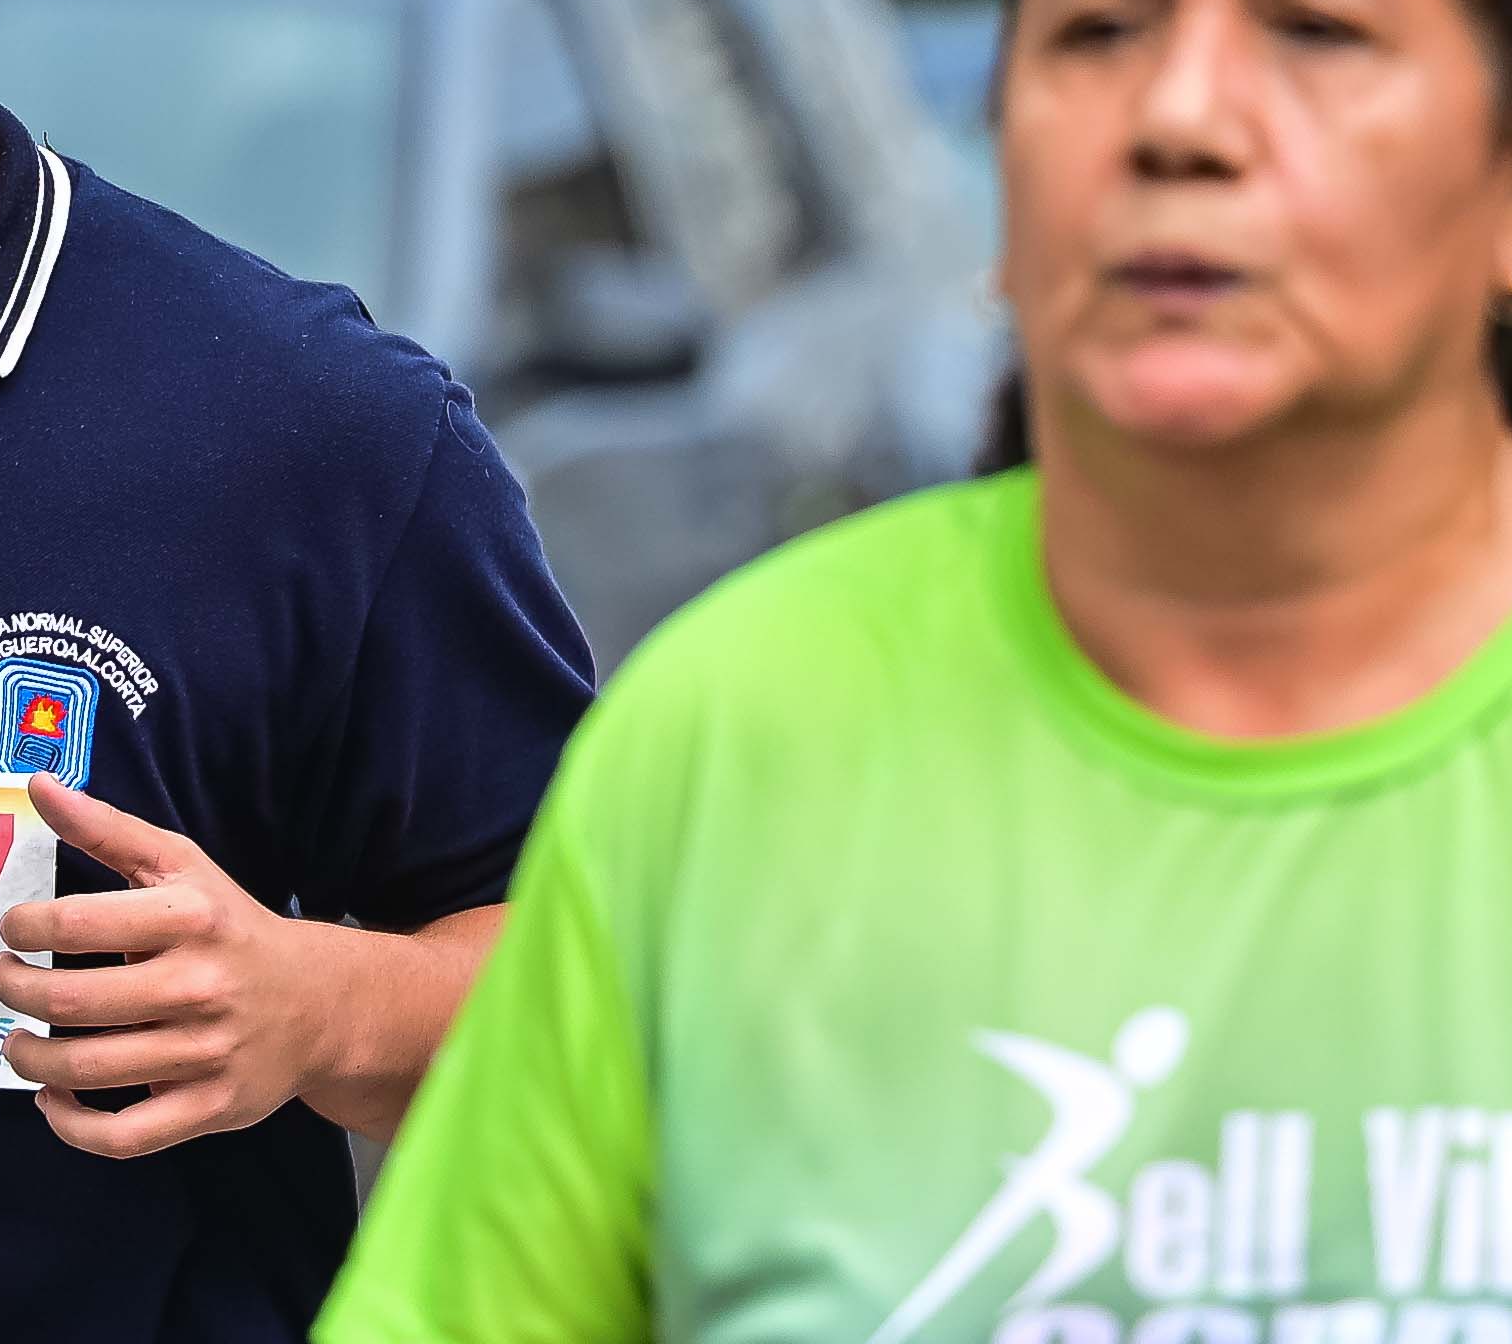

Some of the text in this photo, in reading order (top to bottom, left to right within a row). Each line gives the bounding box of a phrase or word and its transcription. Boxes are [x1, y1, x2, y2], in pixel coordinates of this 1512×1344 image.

[10, 612, 88, 639] NORMAL
[87, 624, 160, 696] SUPERIOR
[76, 652, 148, 721] ALCORTA
